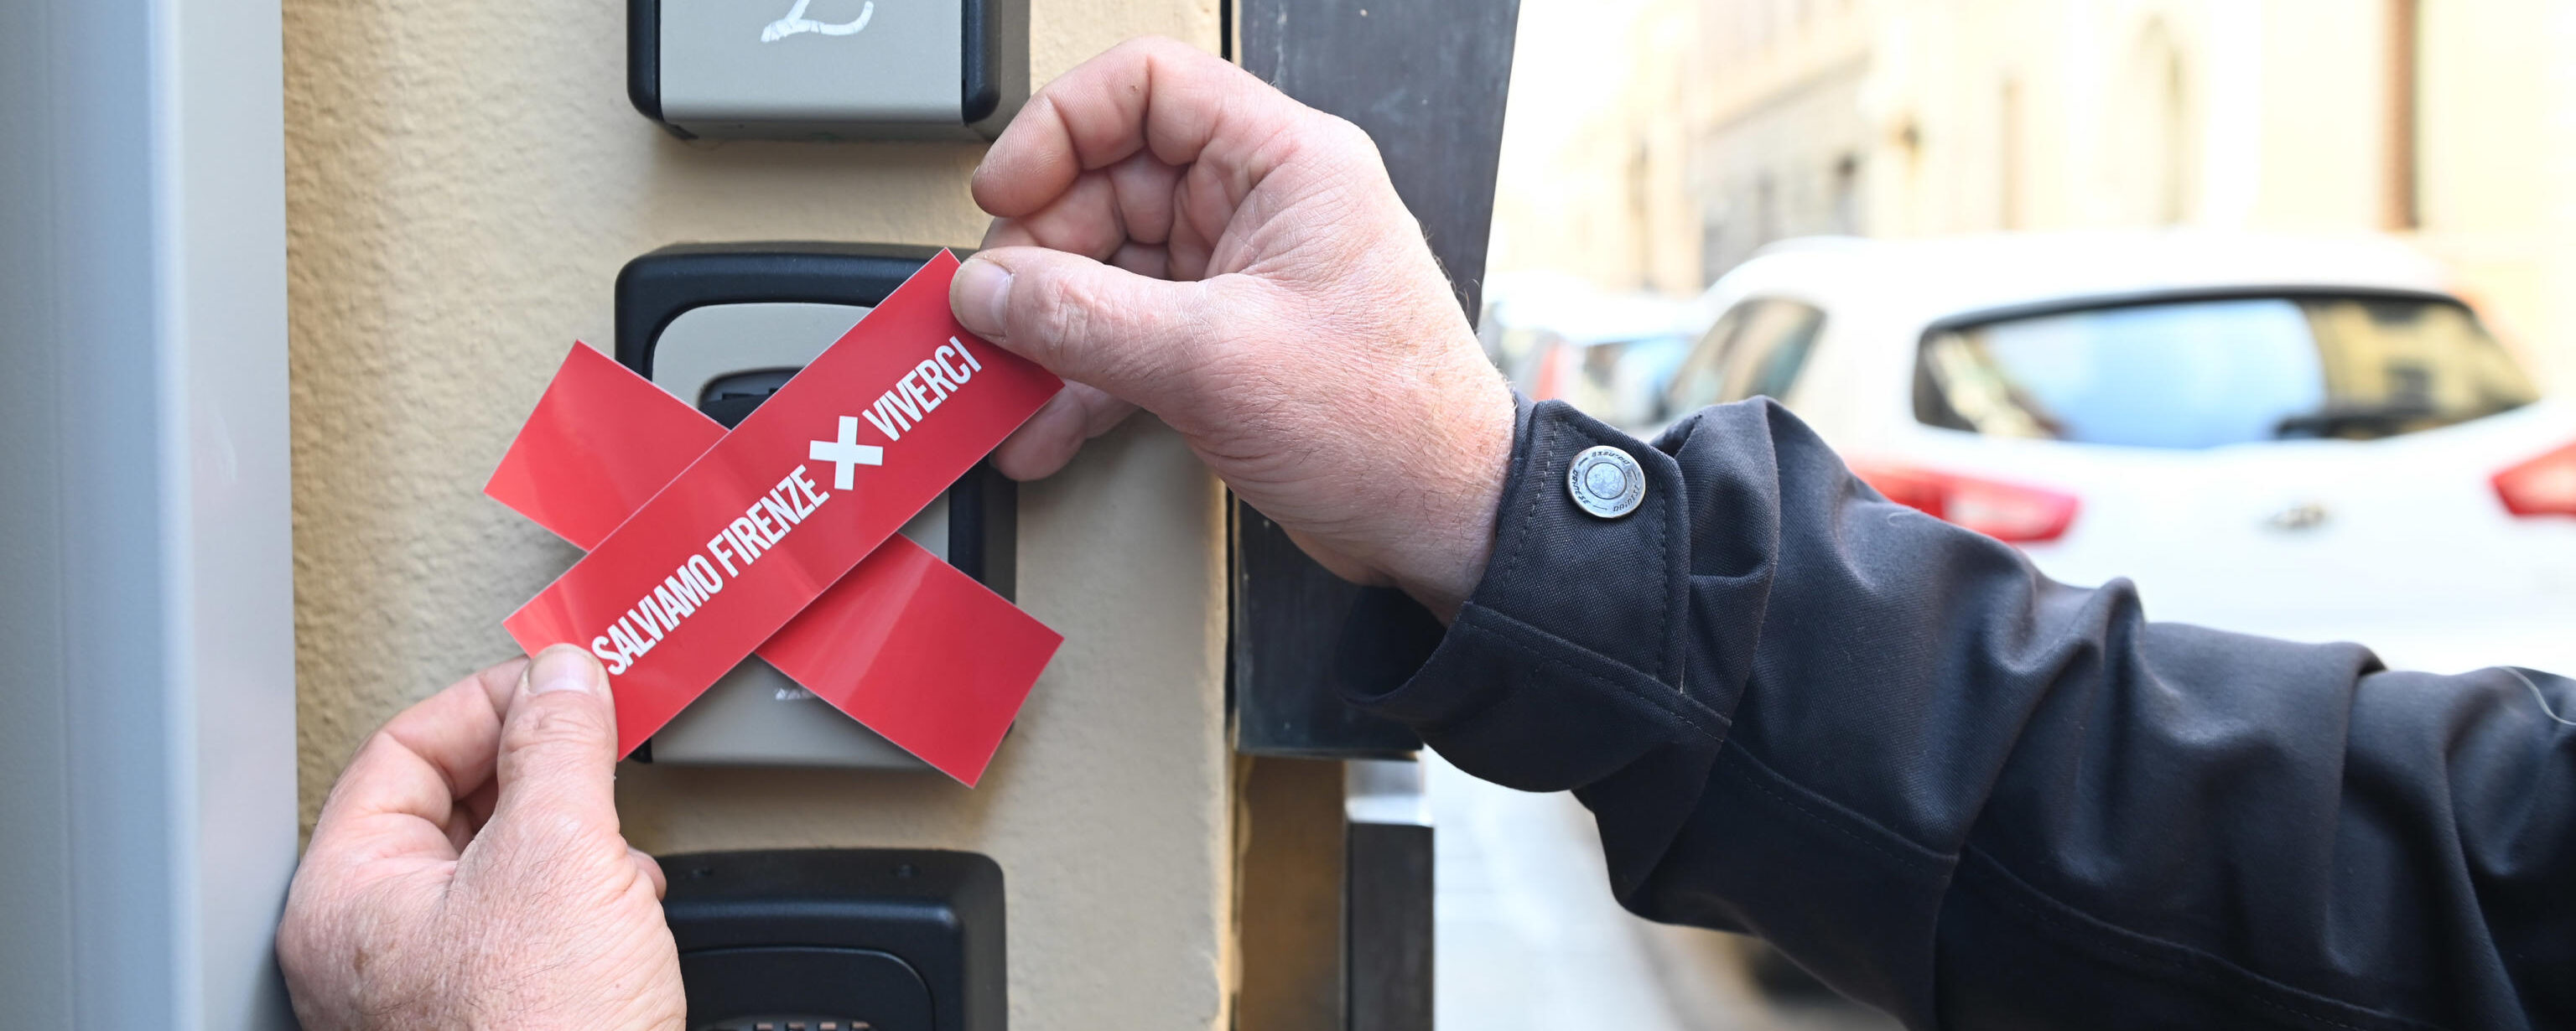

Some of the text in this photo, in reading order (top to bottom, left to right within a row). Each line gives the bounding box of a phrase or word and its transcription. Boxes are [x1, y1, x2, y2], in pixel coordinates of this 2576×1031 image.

[591, 554, 724, 676] SALVIAMO
[706, 464, 830, 578] FIRENZE
[861, 335, 982, 442] VIVERCI
